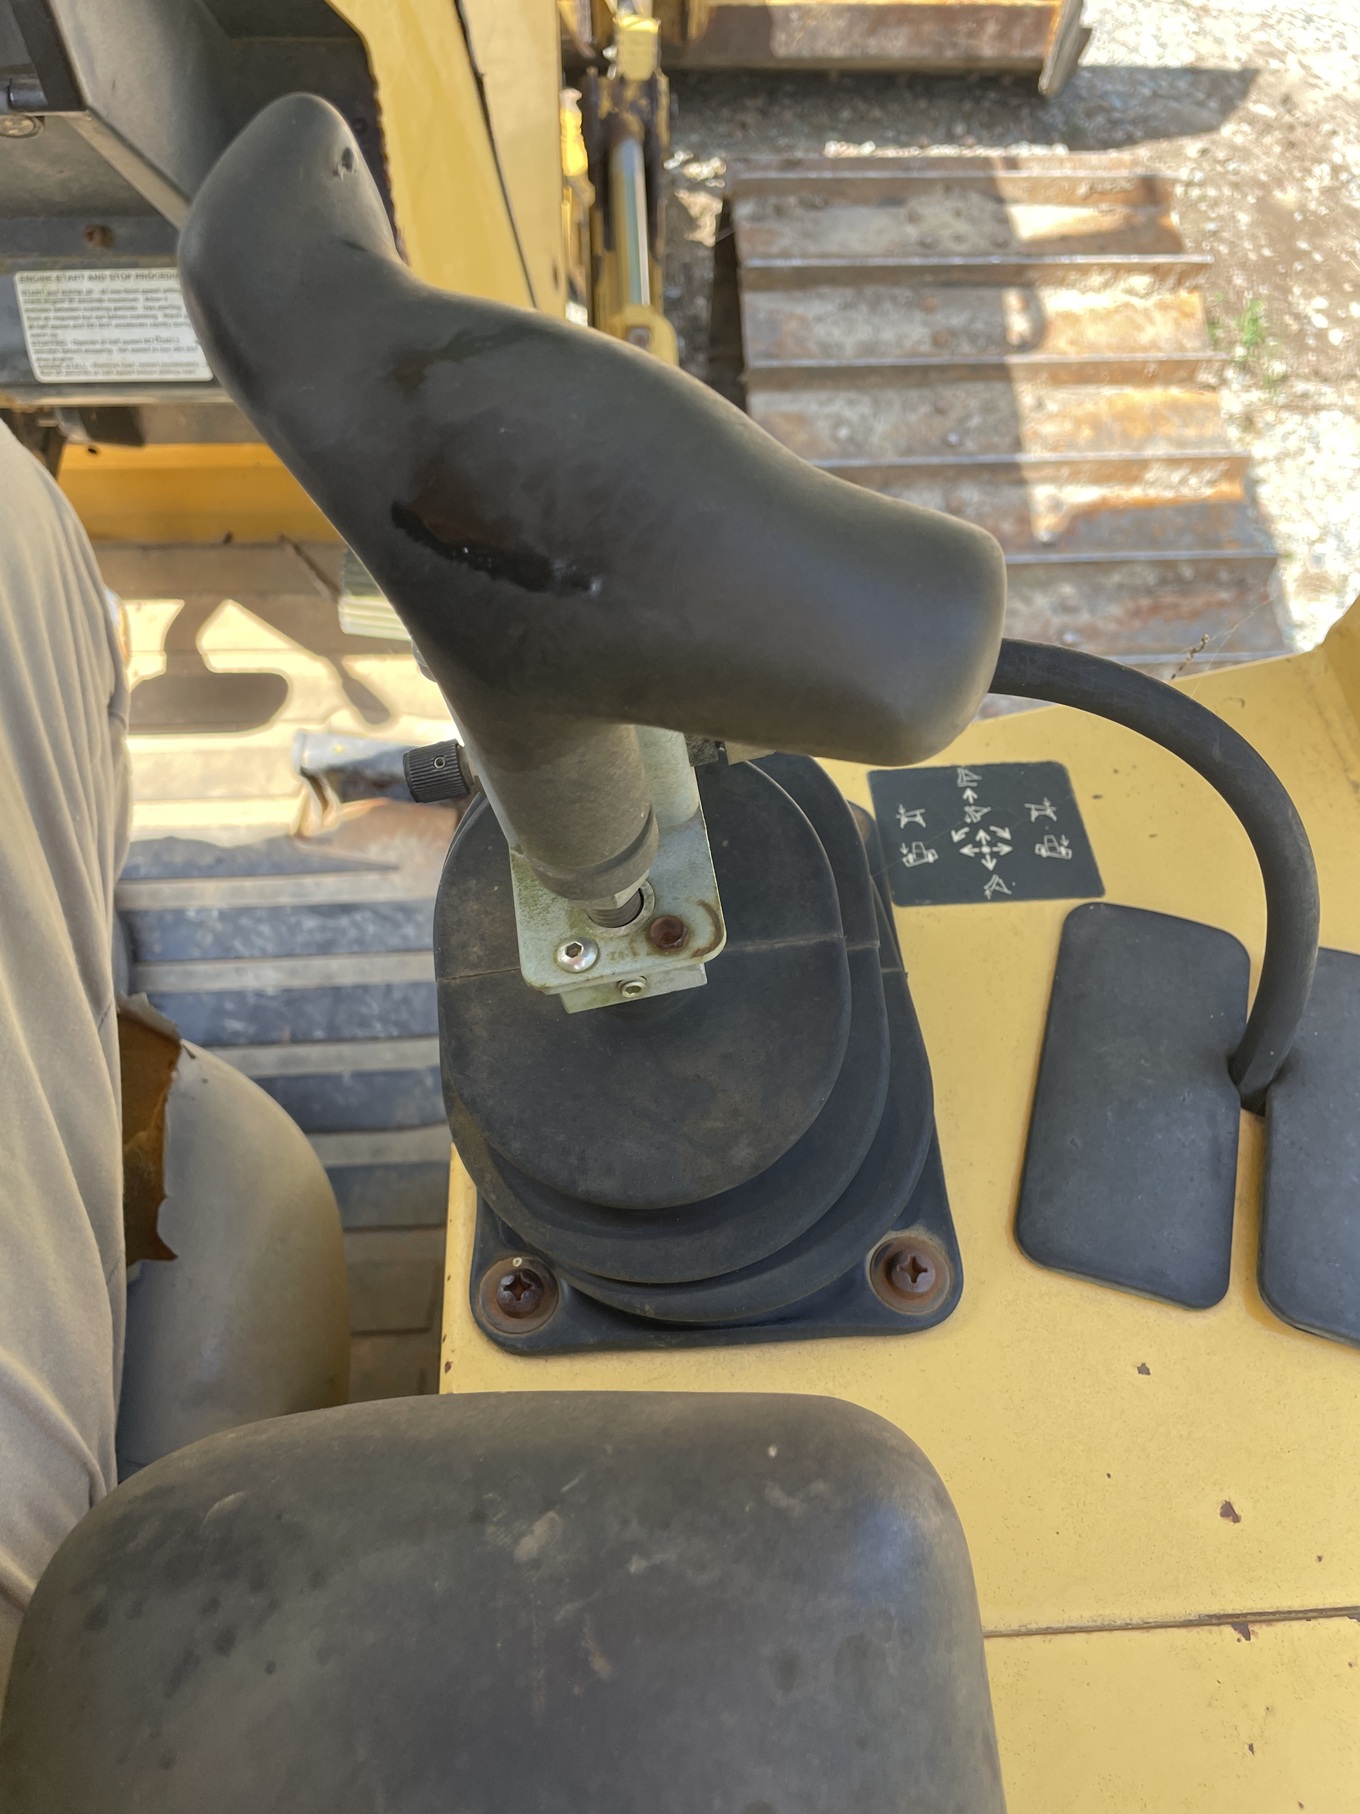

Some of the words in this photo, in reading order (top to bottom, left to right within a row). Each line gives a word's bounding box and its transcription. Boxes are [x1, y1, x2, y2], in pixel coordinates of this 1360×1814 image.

[55, 274, 85, 283] START
[88, 273, 107, 282] AND
[109, 273, 132, 282] STOP
